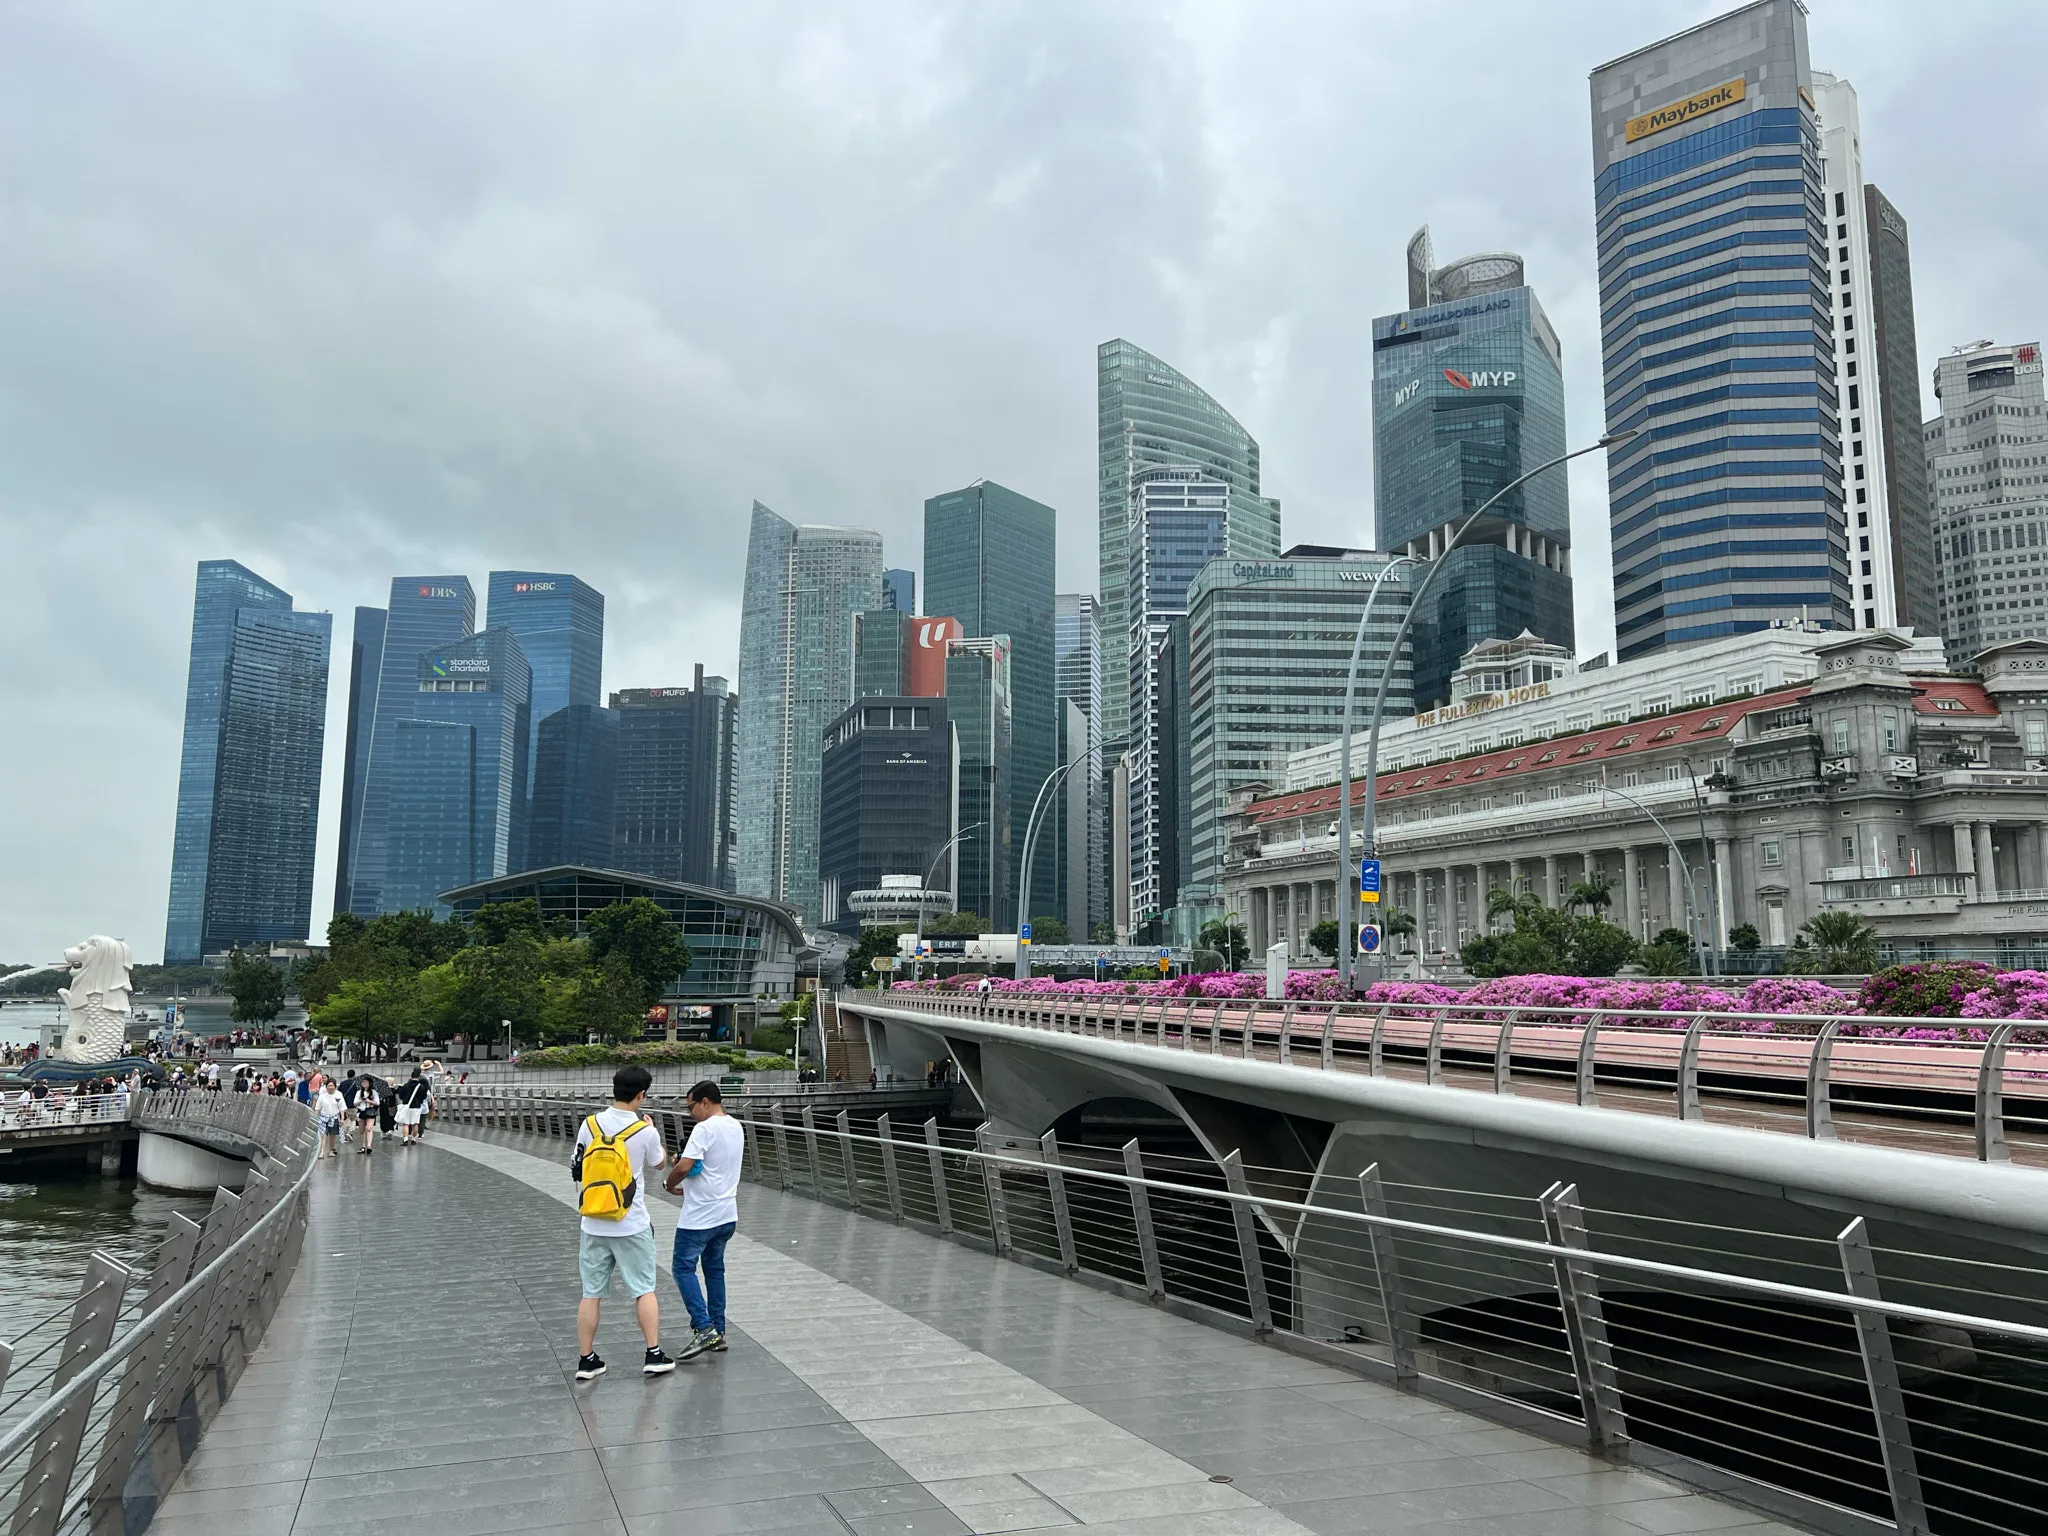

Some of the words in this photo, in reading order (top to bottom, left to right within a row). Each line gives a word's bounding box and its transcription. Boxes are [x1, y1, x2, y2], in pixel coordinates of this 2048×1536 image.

[1650, 87, 1732, 129] Maybank
[1414, 299, 1511, 328] SINGAPORELAND
[2014, 363, 2042, 375] UOB
[1472, 371, 1516, 387] MYP
[1395, 378, 1420, 408] MYP
[1233, 561, 1294, 580] CapitaLand
[429, 586, 457, 598] DBS
[530, 582, 556, 591] HSBC
[450, 664, 490, 673] chartered
[662, 689, 686, 697] MUFG
[1415, 713, 1436, 729] THE
[1439, 693, 1505, 722] FULLERTON
[1508, 682, 1552, 705] HOTEL
[2008, 906, 2025, 915] THE
[938, 941, 958, 949] ERP
